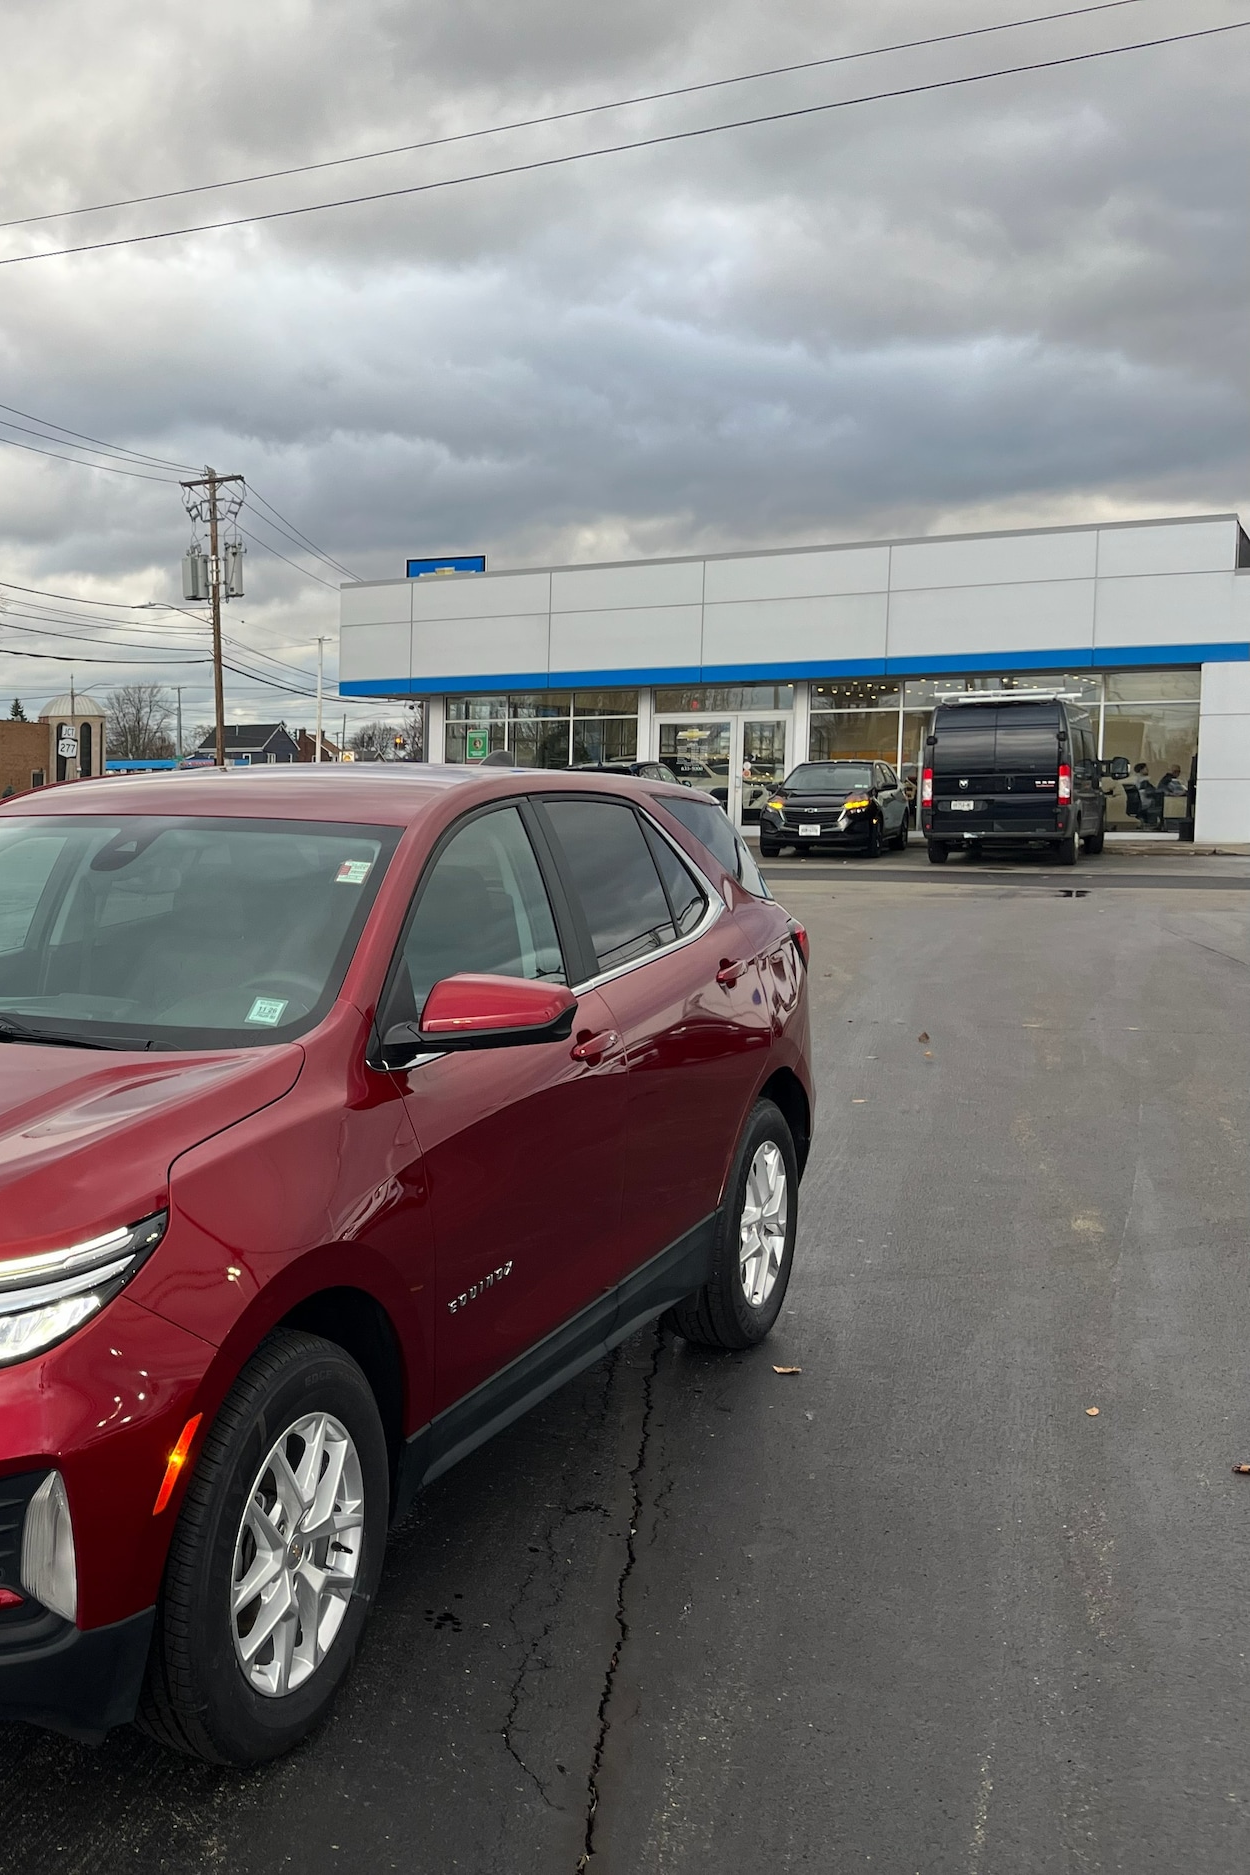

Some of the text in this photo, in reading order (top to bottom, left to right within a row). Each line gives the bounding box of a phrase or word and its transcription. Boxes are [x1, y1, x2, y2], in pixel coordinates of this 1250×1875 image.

[63, 727, 75, 737] JCT
[60, 743, 76, 754] 277
[447, 1260, 513, 1314] EQUINOX
